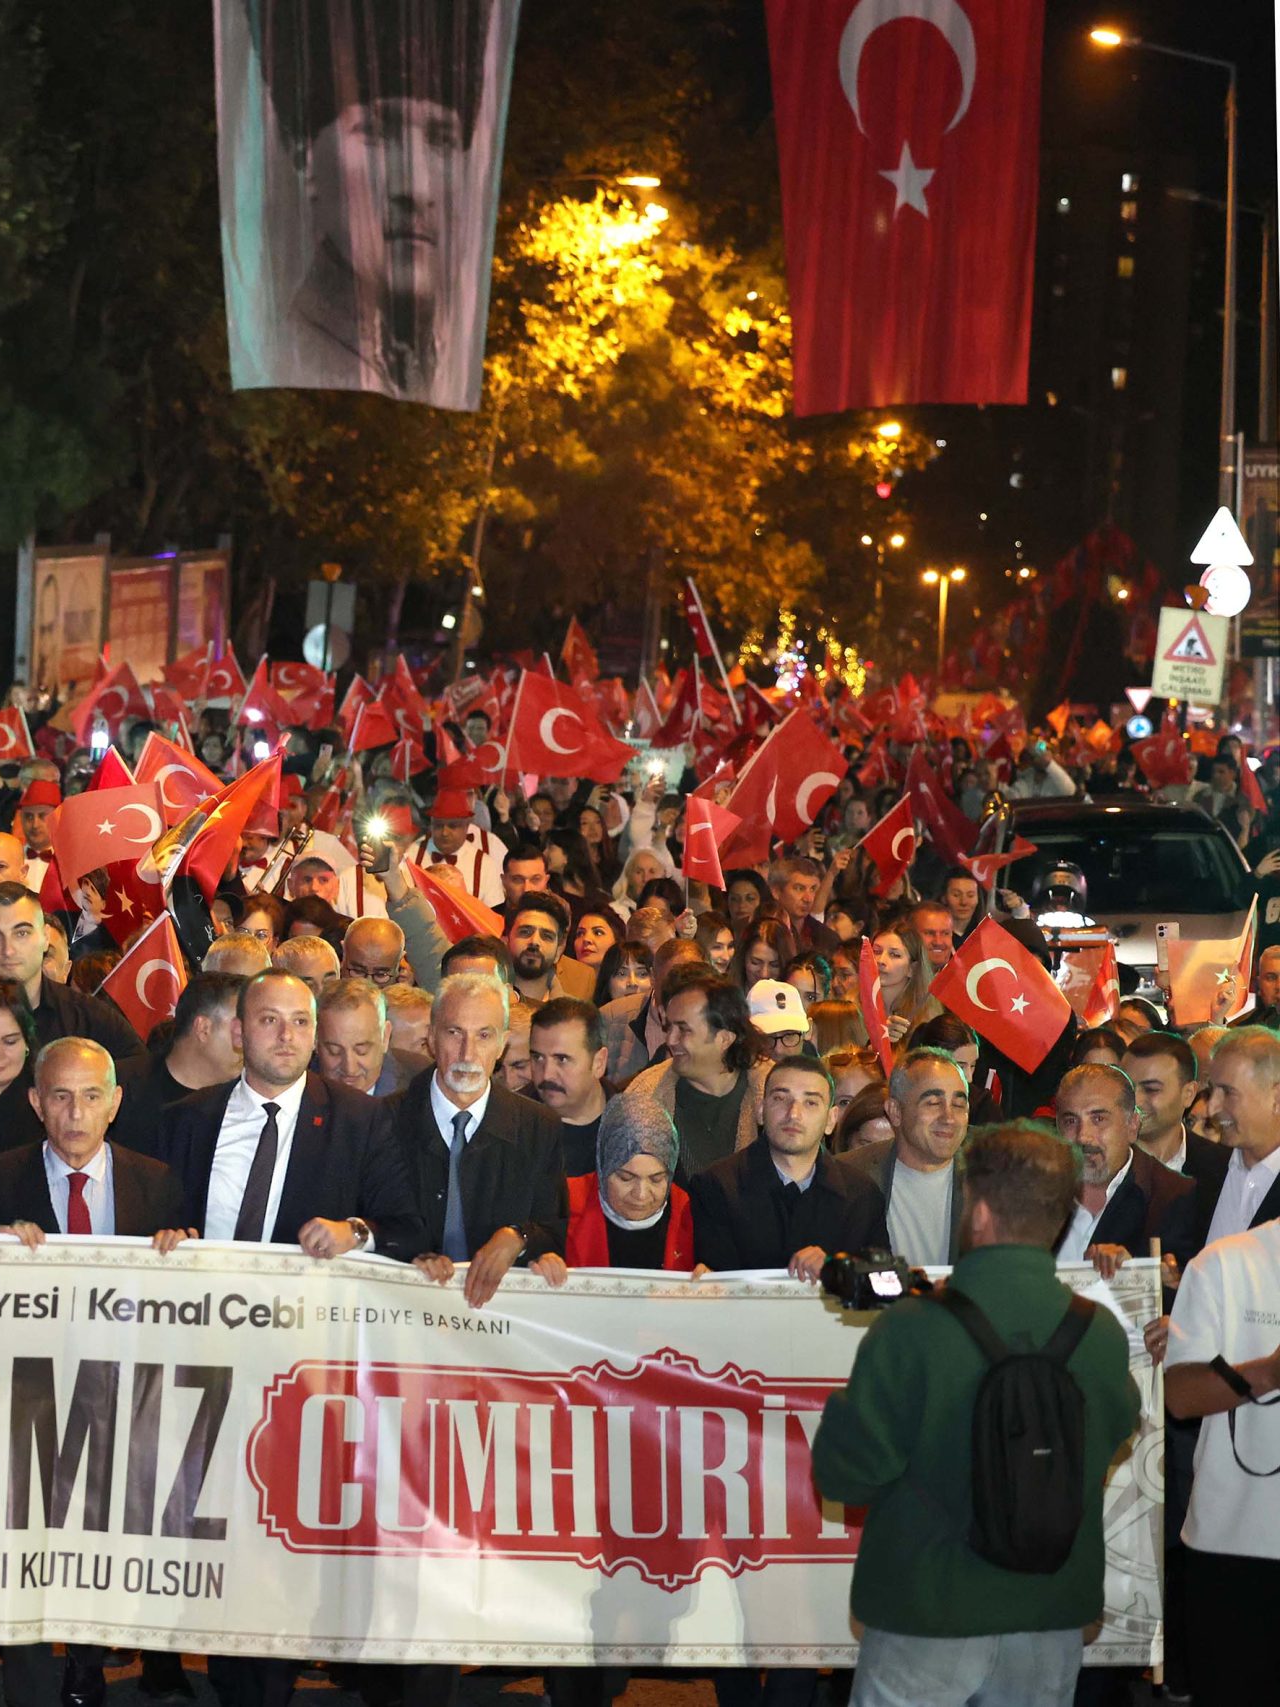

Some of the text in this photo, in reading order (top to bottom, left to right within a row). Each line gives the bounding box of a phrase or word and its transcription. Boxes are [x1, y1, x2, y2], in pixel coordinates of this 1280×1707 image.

[88, 1287, 210, 1326] Kemal
[219, 1295, 304, 1329] Çebi
[20, 1551, 112, 1590] KUTLU
[123, 1557, 224, 1599] OLSUN
